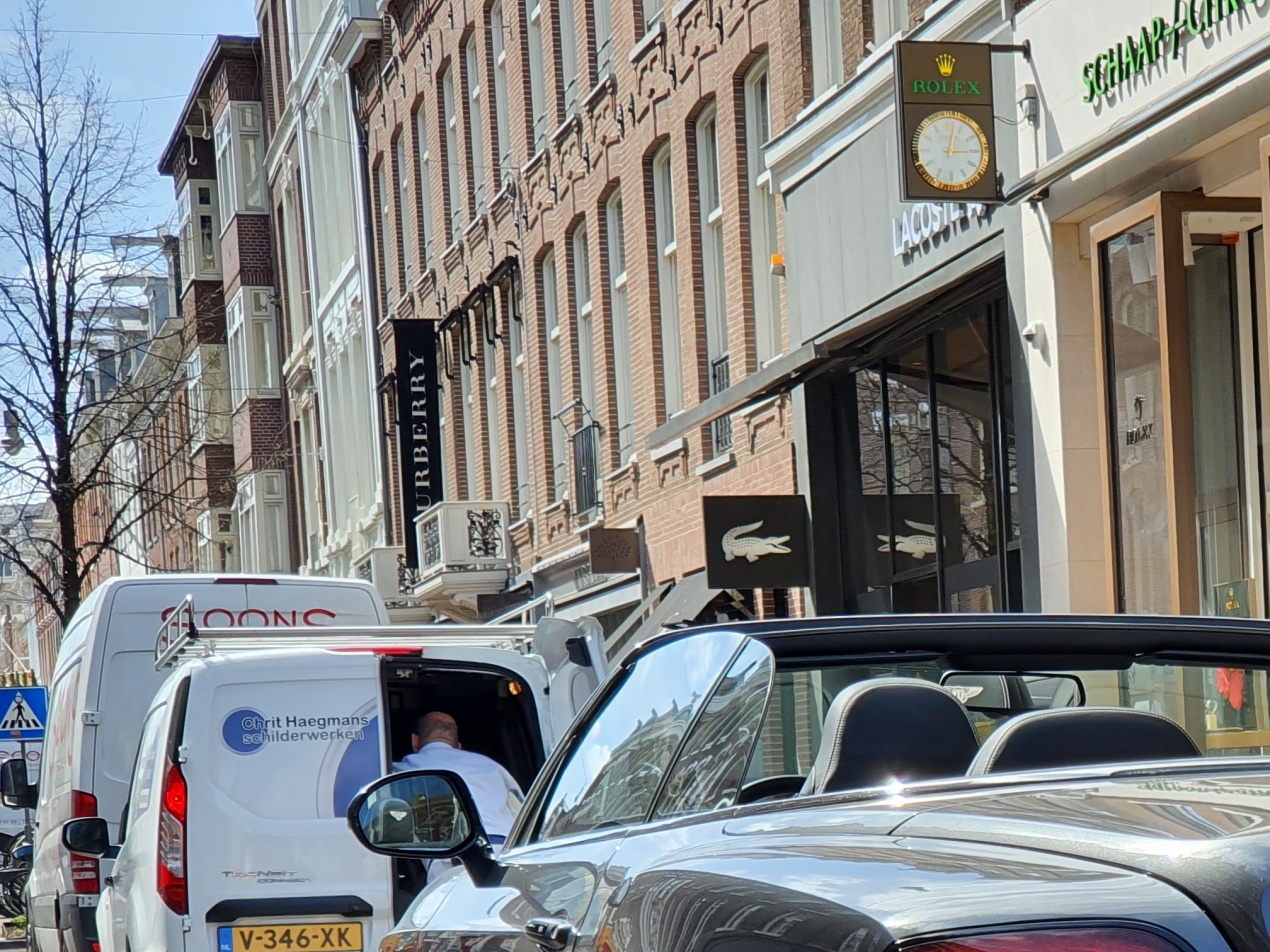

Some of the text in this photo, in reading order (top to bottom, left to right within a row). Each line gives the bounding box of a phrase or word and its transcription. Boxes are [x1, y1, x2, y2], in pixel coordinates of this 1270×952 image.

[912, 79, 981, 95] ROLEX
[409, 350, 433, 513] URBERRY
[242, 715, 370, 730] Chrit Haegmans
[242, 729, 365, 745] schilderwerken
[239, 927, 352, 950] V-346-XK
